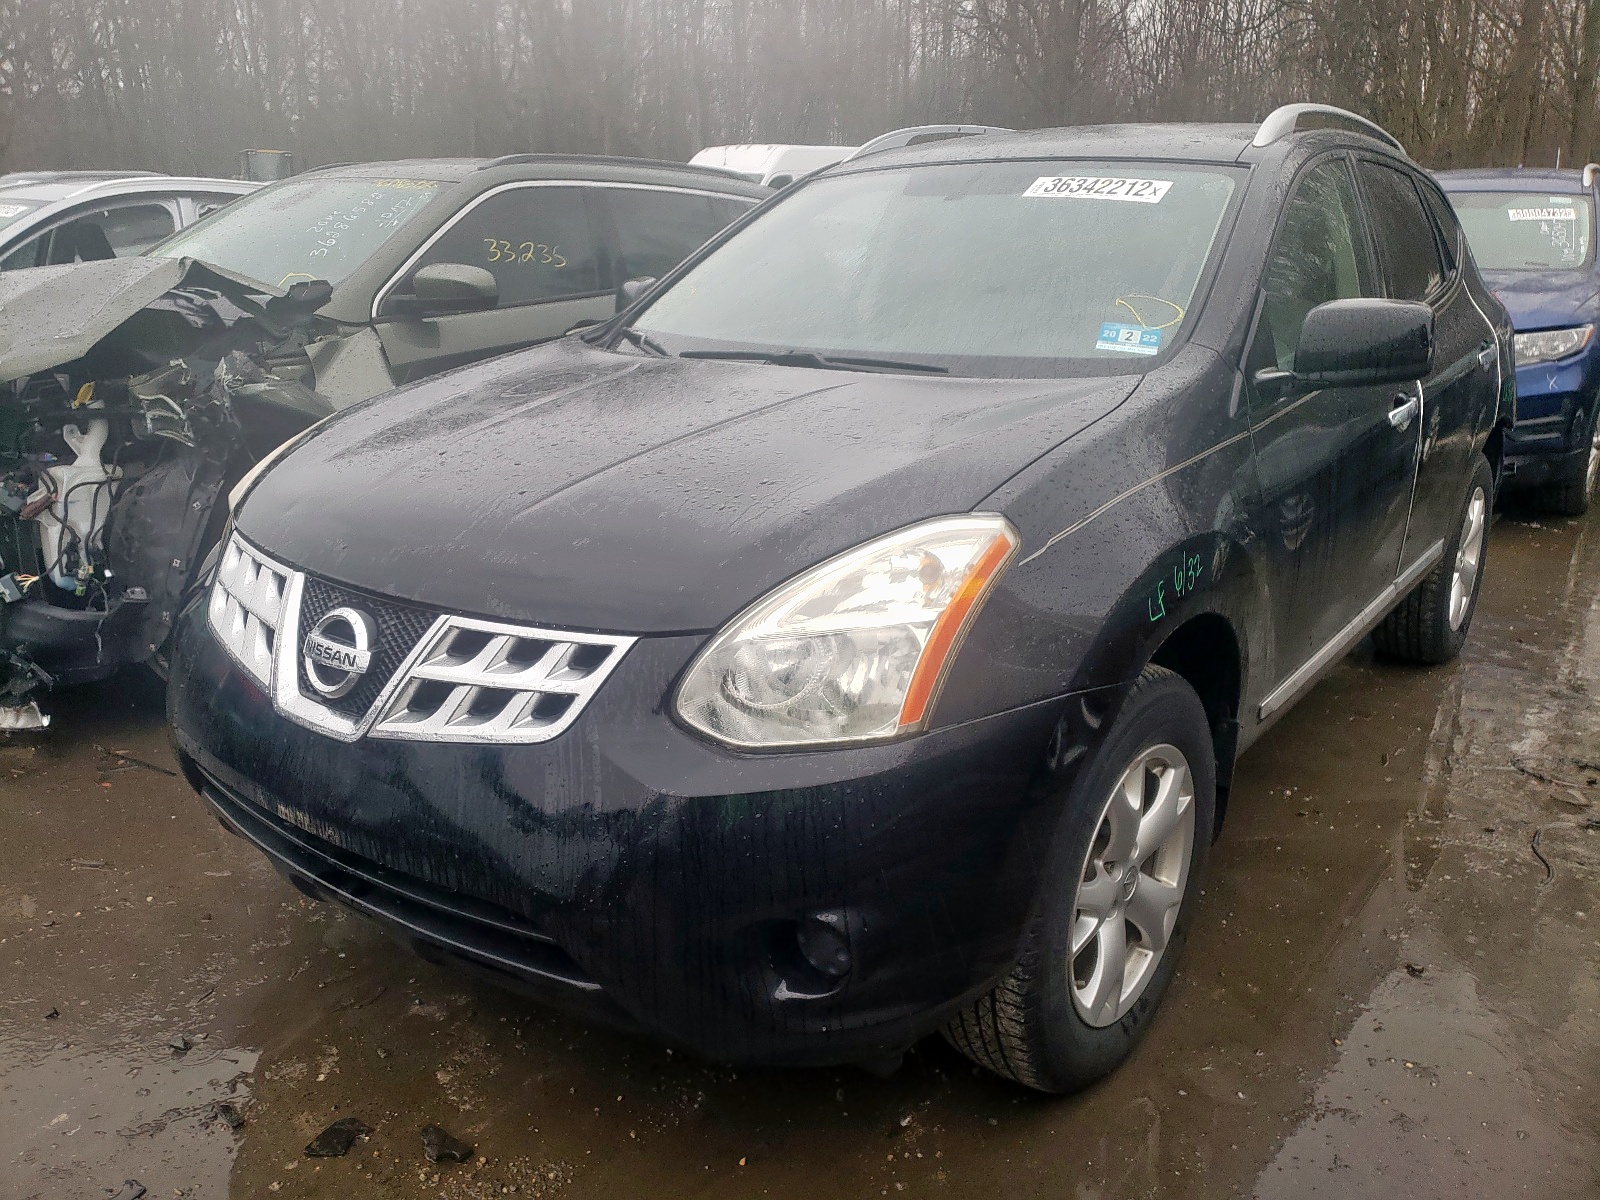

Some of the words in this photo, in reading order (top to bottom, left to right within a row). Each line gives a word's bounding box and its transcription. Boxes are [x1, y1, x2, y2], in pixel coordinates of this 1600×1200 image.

[483, 238, 567, 268] 33,235
[1102, 329, 1117, 338] 20
[1124, 331, 1134, 342] 2
[1142, 334, 1158, 343] 22
[305, 638, 357, 668] NISSAN
